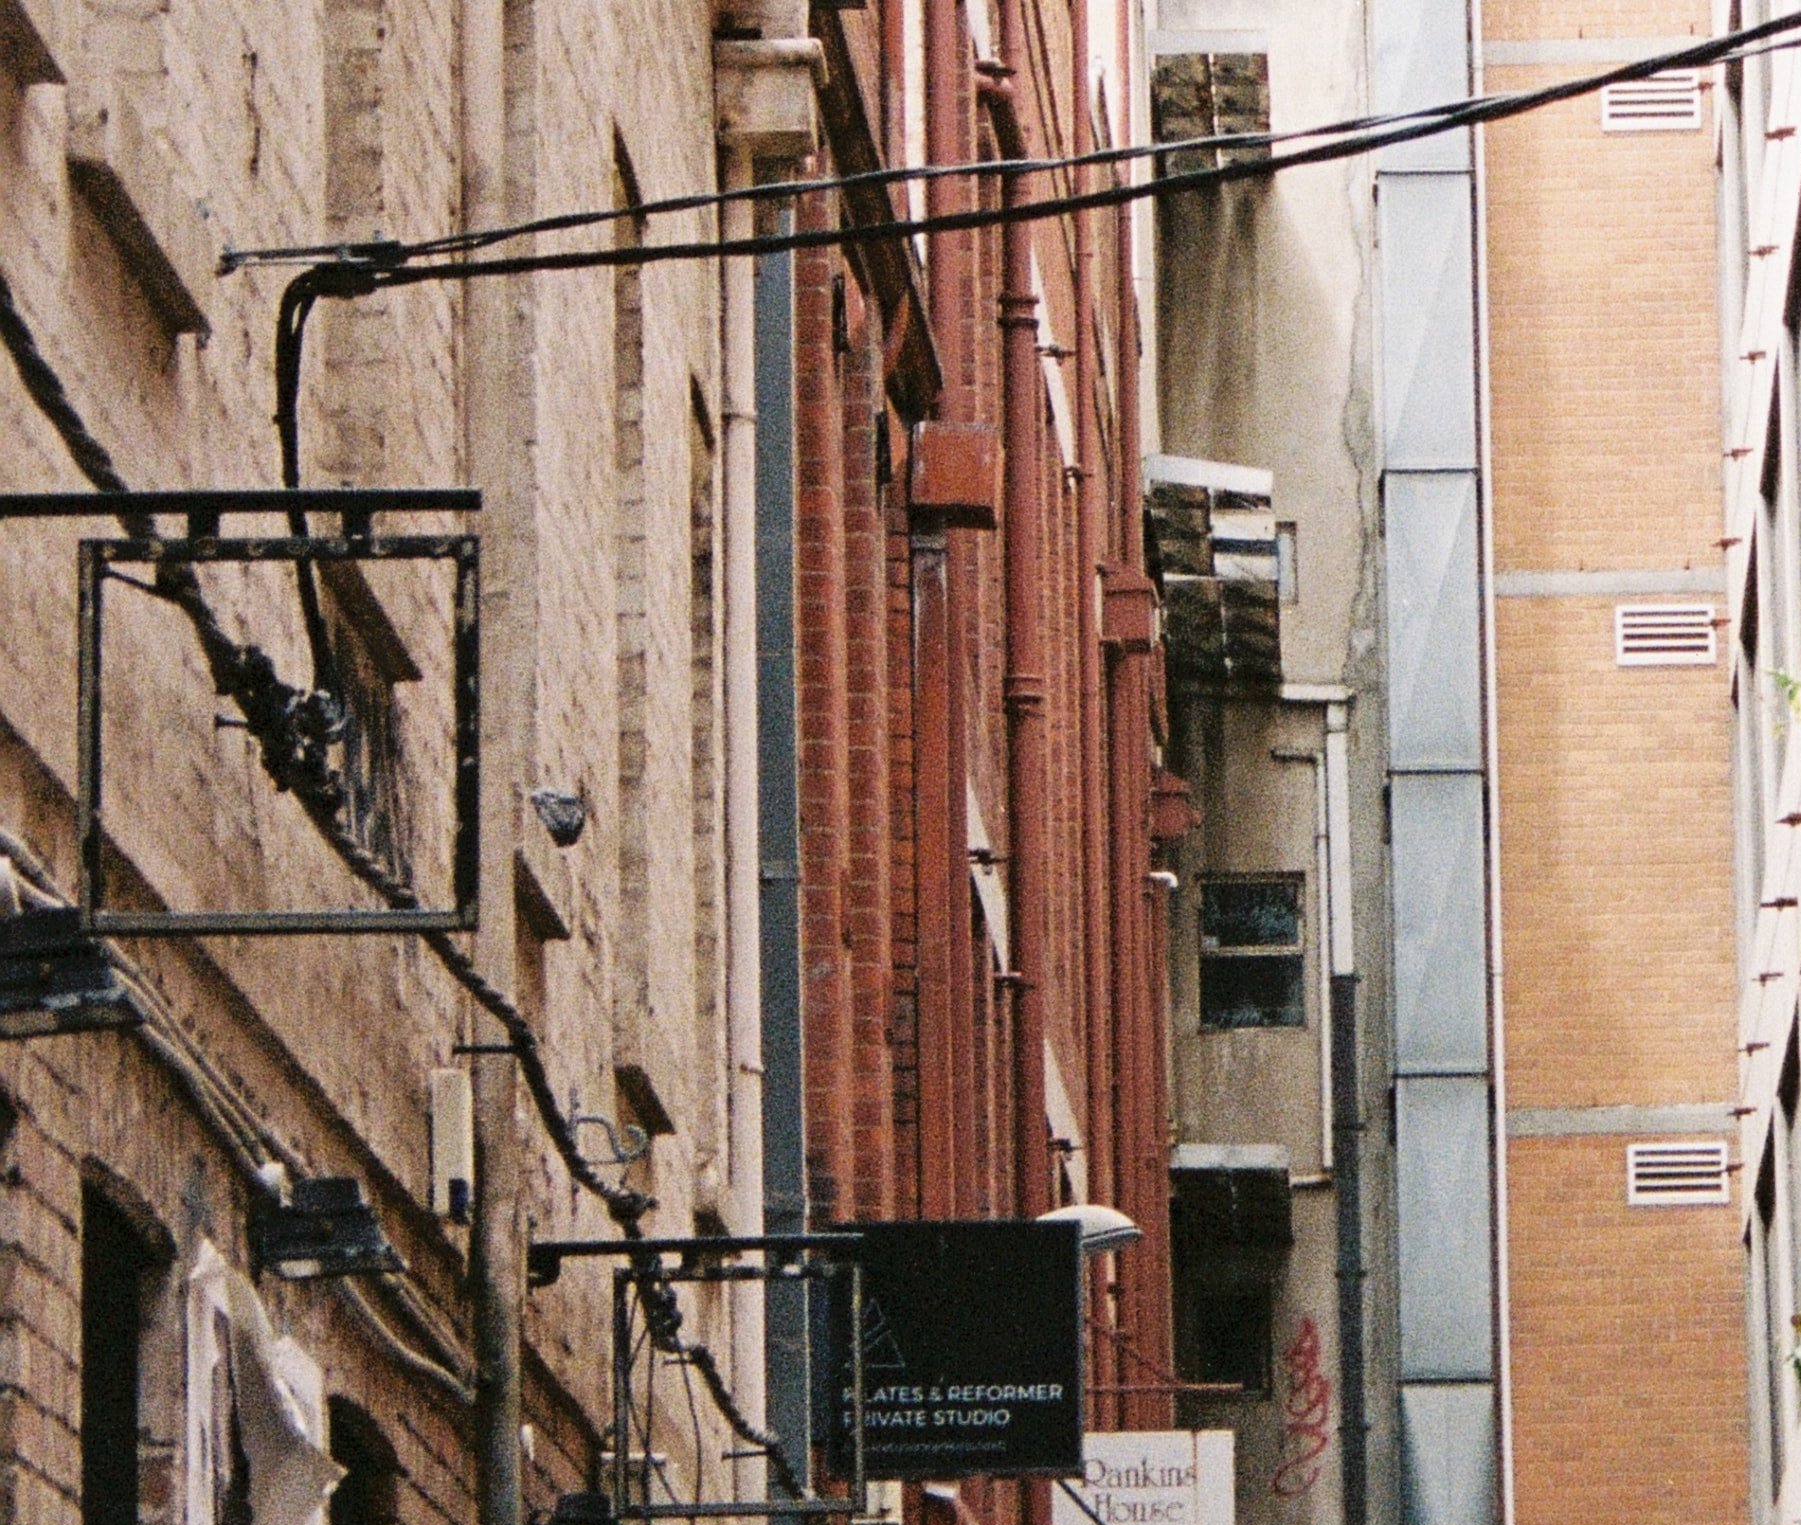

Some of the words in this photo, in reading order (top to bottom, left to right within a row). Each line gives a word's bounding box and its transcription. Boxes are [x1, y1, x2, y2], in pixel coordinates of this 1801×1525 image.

[948, 1384, 1064, 1401] REFORMER
[933, 1408, 1011, 1426] STUDIO
[1094, 1492, 1186, 1523] House
